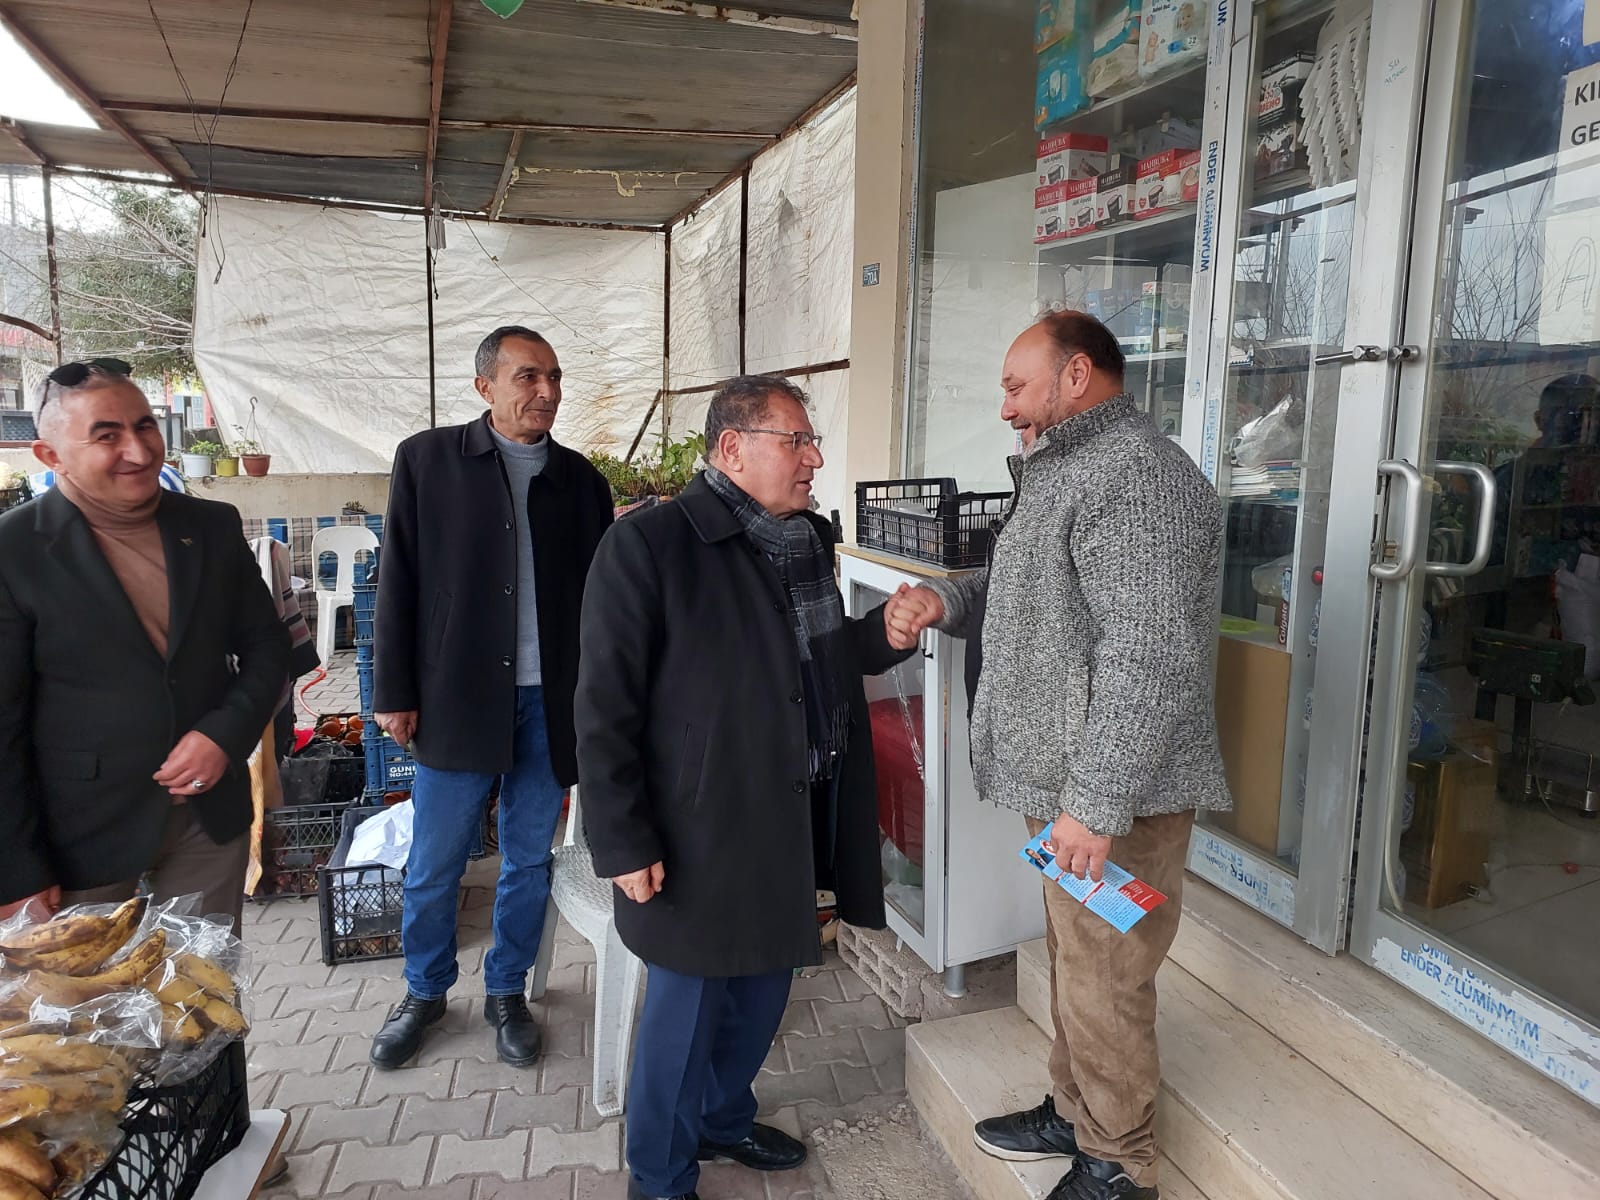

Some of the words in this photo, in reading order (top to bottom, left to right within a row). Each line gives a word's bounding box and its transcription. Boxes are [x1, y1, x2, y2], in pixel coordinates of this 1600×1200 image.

[1574, 80, 1600, 106] KI
[1206, 140, 1219, 185] ENDER
[1279, 602, 1289, 644] Colgate
[1230, 863, 1269, 896] ENDER
[1400, 947, 1442, 983] ENDER
